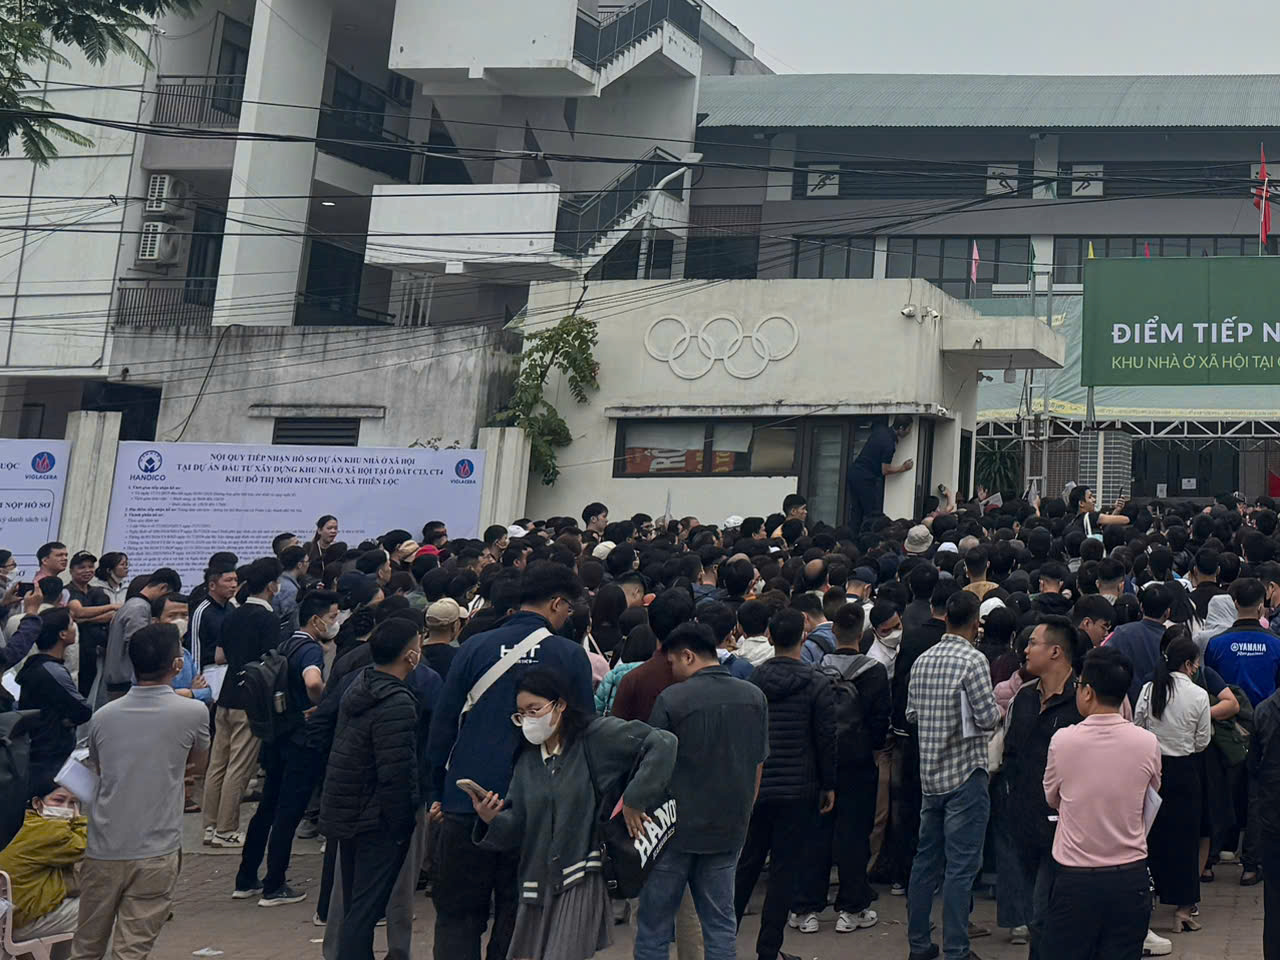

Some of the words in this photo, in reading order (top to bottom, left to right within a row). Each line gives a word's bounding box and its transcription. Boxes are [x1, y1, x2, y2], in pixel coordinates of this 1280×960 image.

[1111, 315, 1183, 344] ĐIỂM
[1193, 315, 1253, 344] TIẾP
[1112, 356, 1143, 369] KHU
[1148, 352, 1180, 369] NHÀ
[1183, 353, 1196, 369] Ở
[1198, 353, 1219, 368] XÃ
[1222, 352, 1249, 371] HỘI
[1252, 355, 1273, 371] TẠI
[129, 474, 166, 482] HANDICO
[39, 501, 51, 509] SƠ
[1239, 642, 1267, 652] YAMAHA
